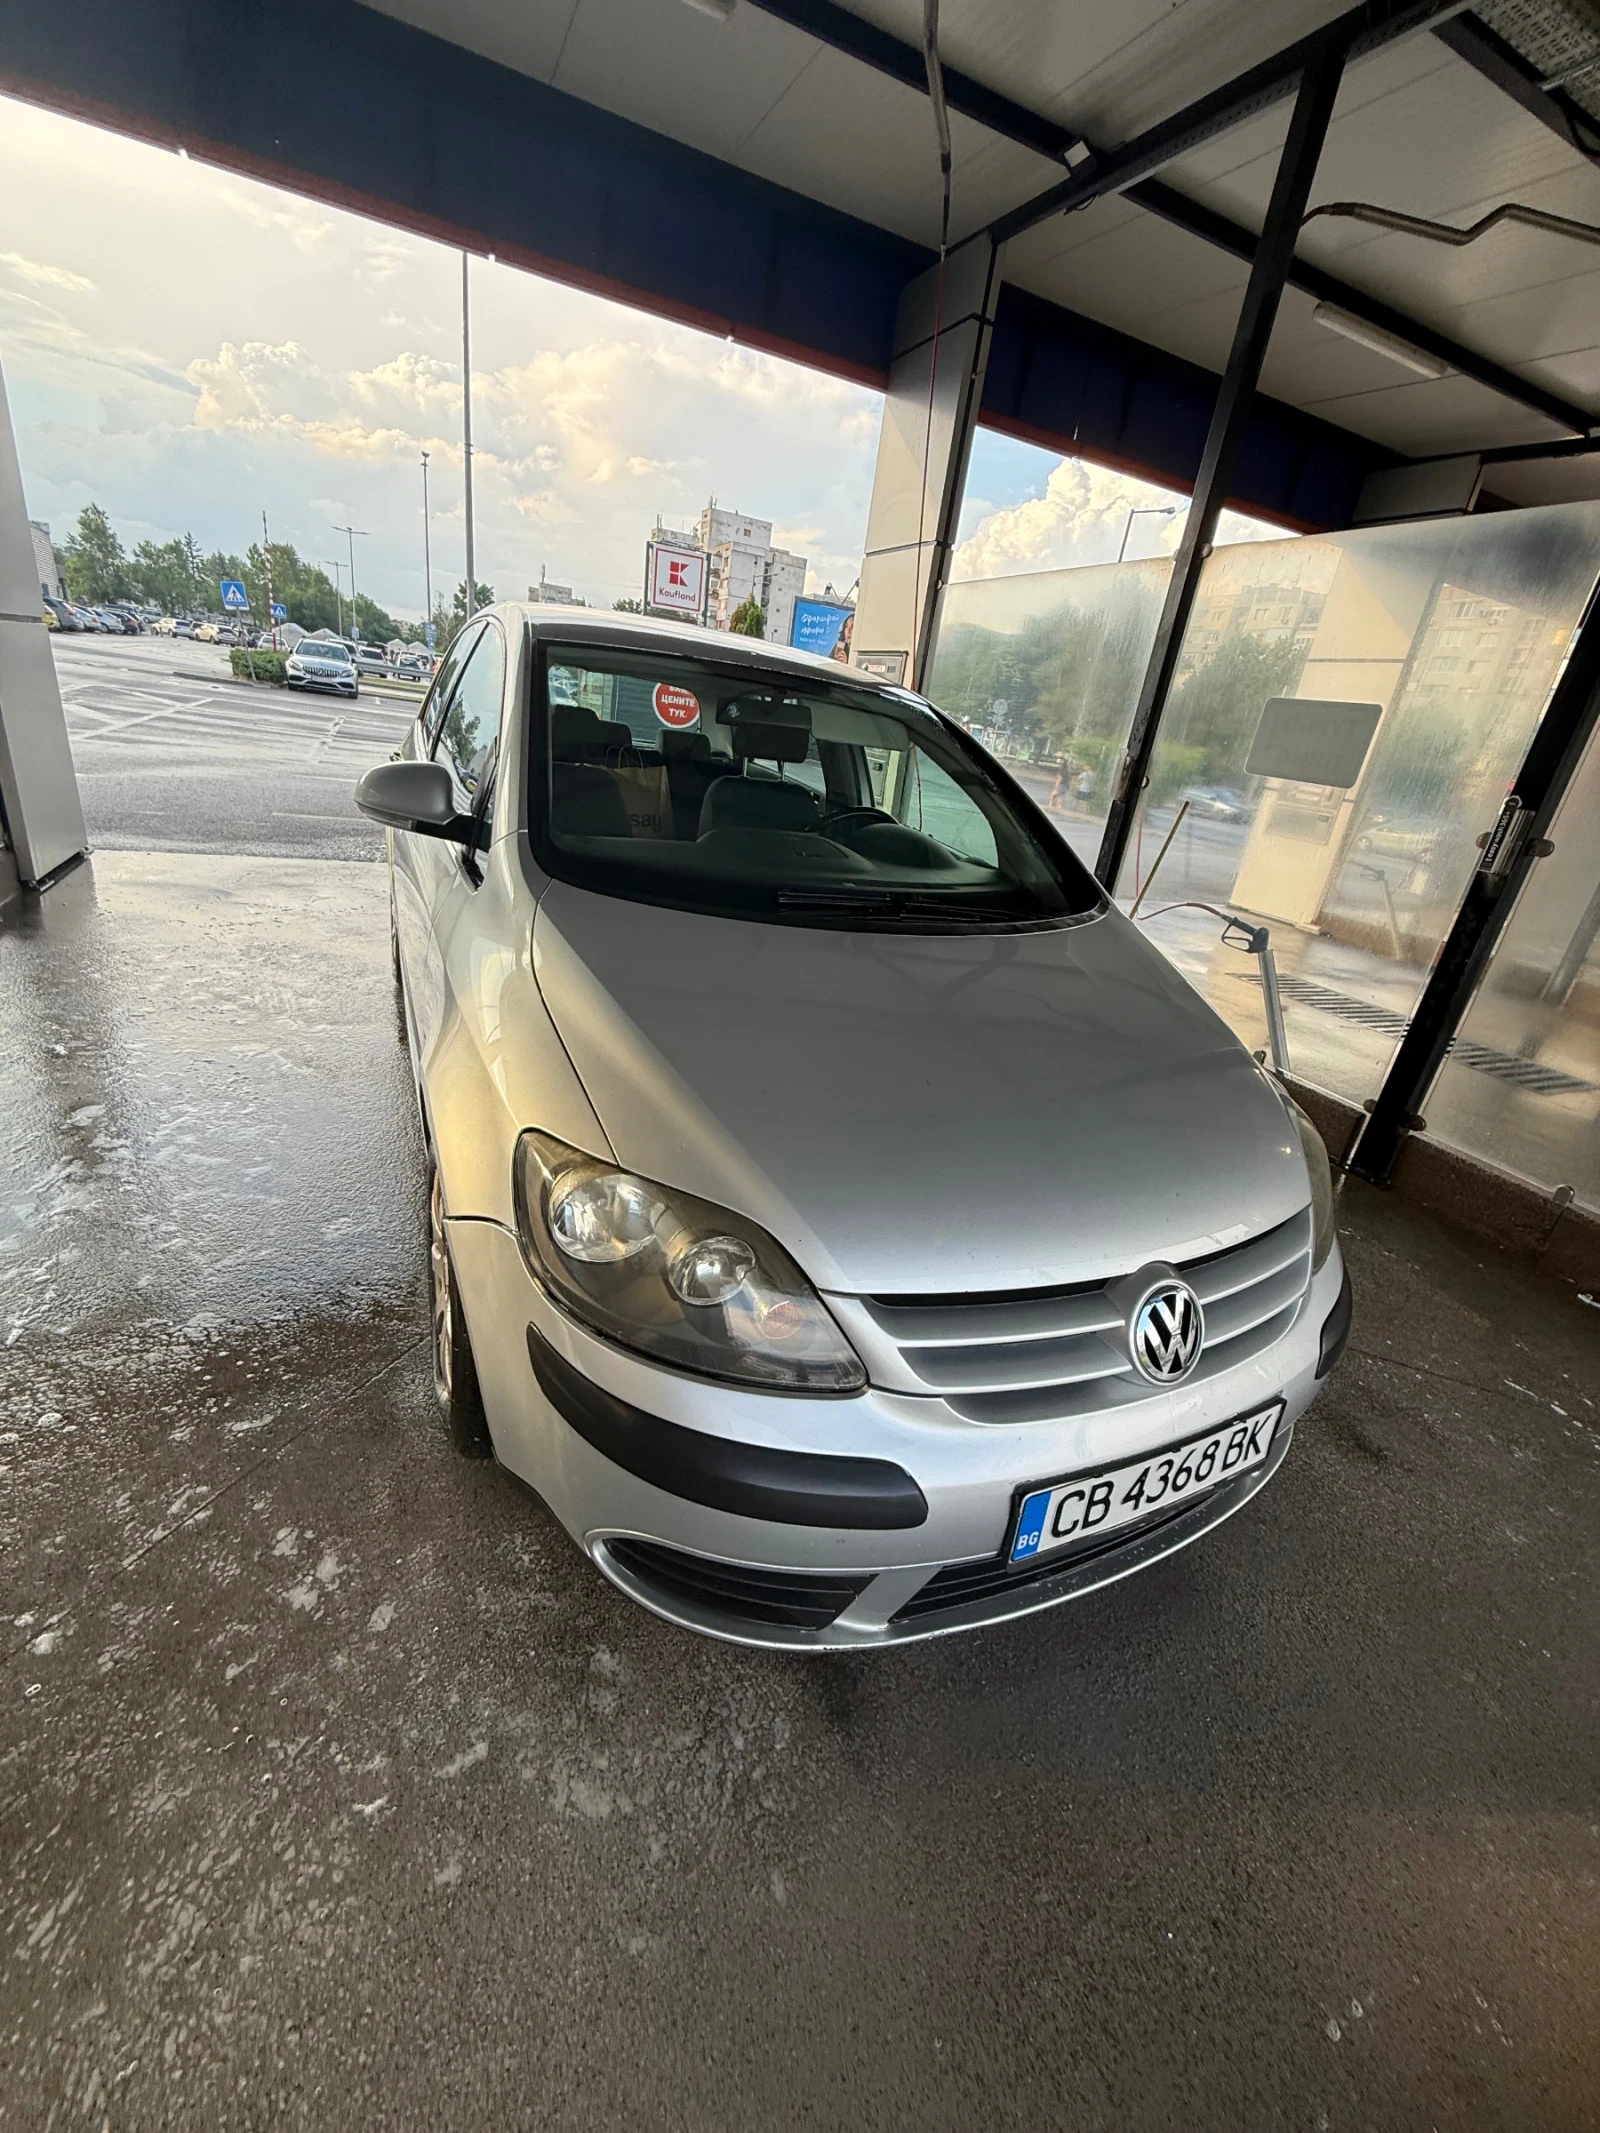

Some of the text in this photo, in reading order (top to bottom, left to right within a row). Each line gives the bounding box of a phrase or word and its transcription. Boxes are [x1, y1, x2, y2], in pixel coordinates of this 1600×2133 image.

[659, 587, 696, 602] Kaufland
[661, 694, 696, 708] ЦЕНИТЕ
[1051, 1413, 1273, 1538] CB 4368 BK
[1017, 1531, 1039, 1550] BG
